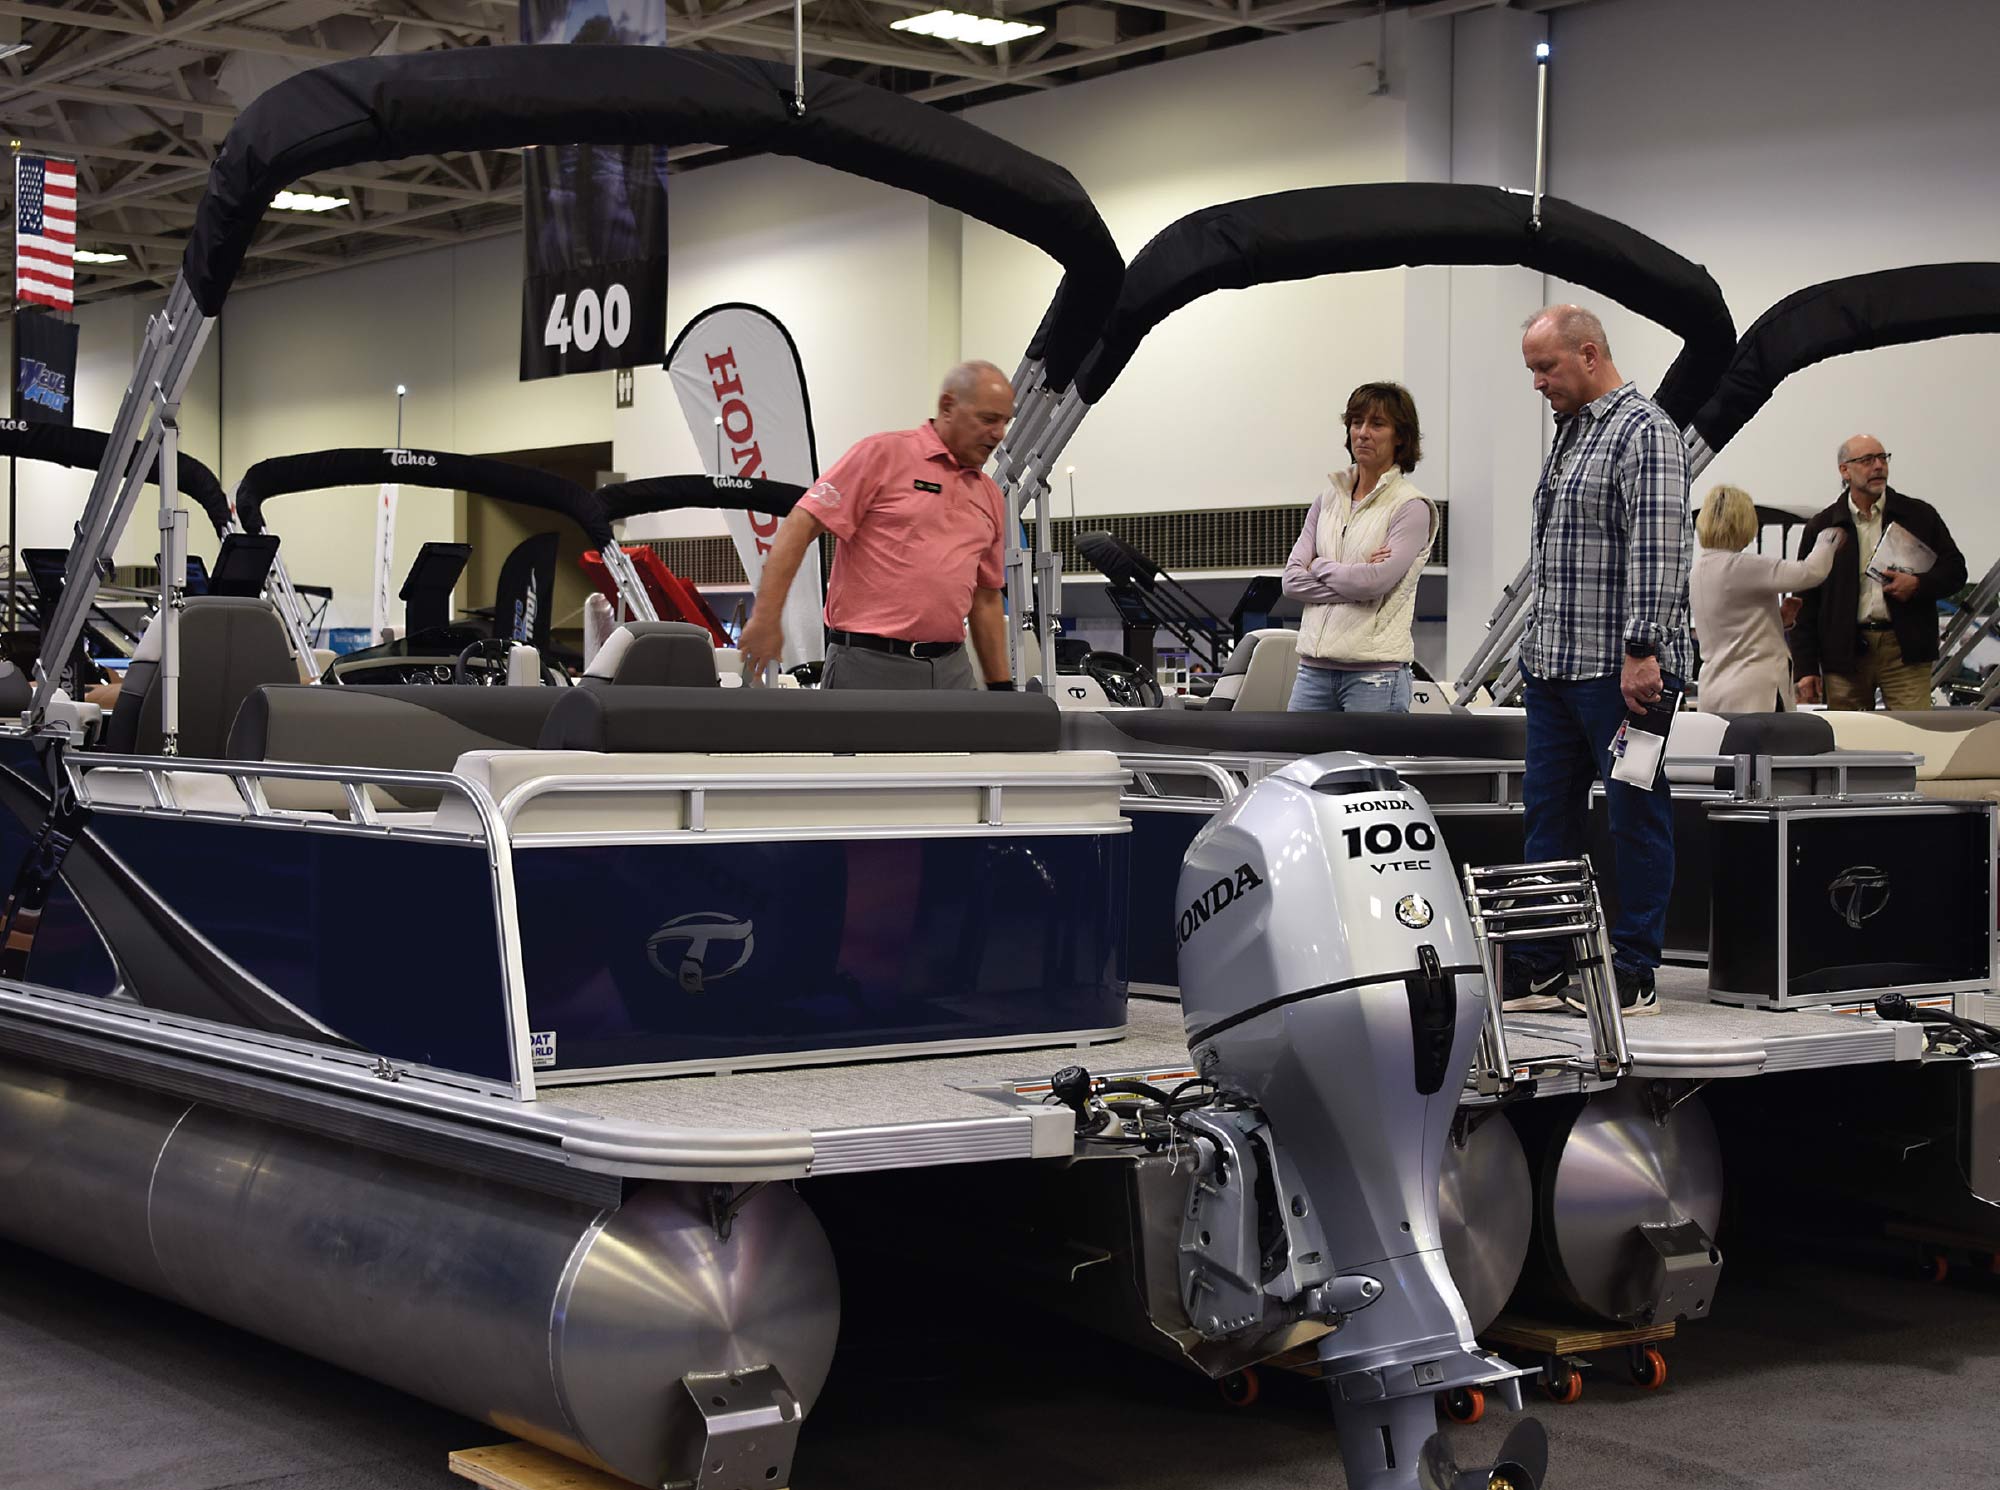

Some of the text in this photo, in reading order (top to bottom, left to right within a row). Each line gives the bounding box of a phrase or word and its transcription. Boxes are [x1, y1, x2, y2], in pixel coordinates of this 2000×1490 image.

[545, 283, 631, 354] 400
[17, 357, 66, 393] Wave
[382, 448, 438, 467] Tahoe
[704, 473, 753, 489] Tahoe
[1343, 800, 1415, 814] HONDA
[1342, 822, 1436, 859] 100
[1370, 860, 1432, 875] VTEC
[531, 1046, 554, 1057] RLD
